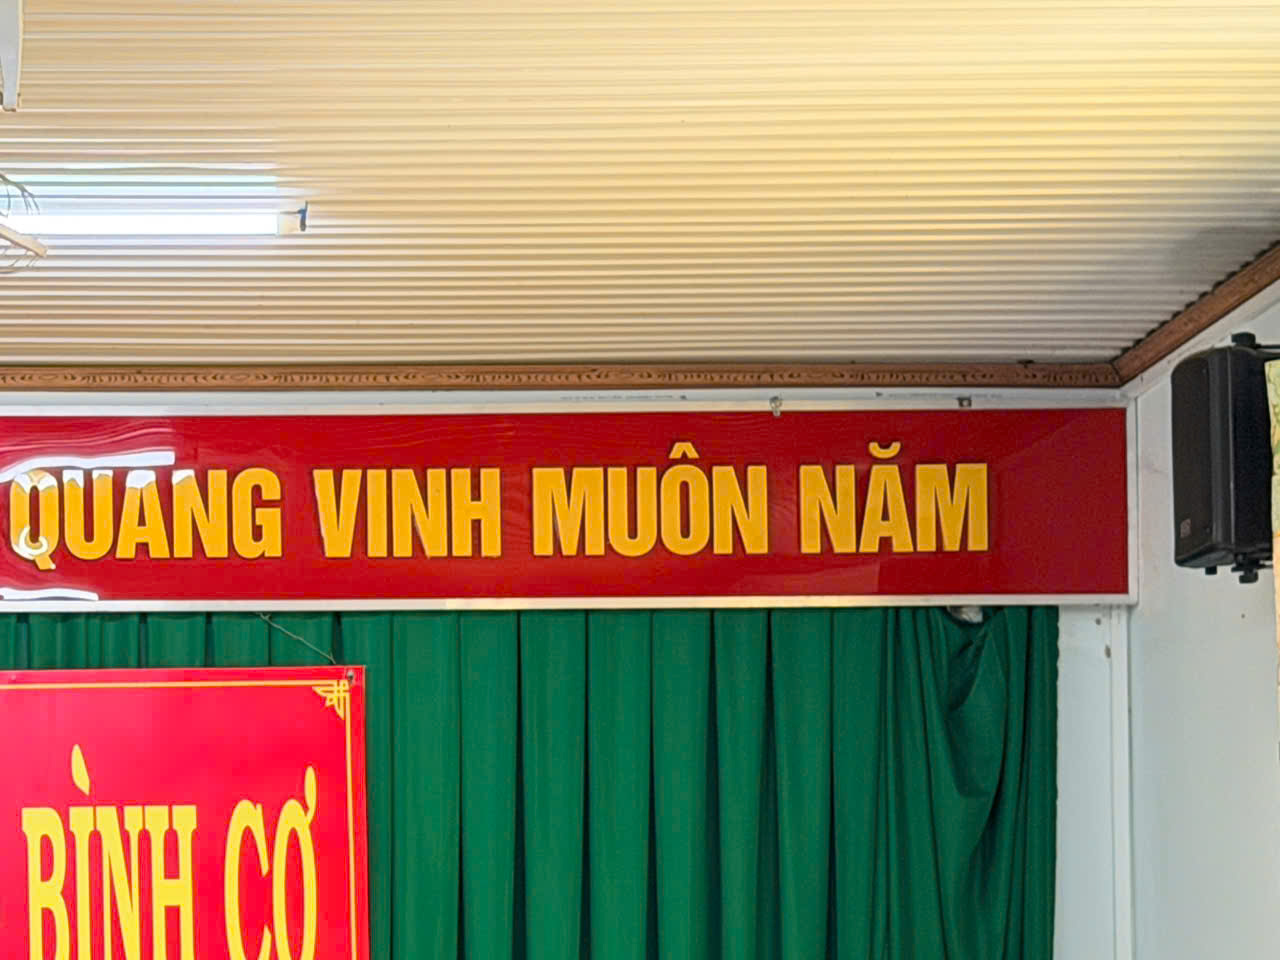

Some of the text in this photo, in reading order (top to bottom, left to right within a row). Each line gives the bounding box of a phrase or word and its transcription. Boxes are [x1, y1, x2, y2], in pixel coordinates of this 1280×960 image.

[9, 469, 282, 570] QUANG
[313, 467, 501, 558] VINH
[531, 442, 768, 556] MUÔN
[798, 441, 988, 553] NĂM
